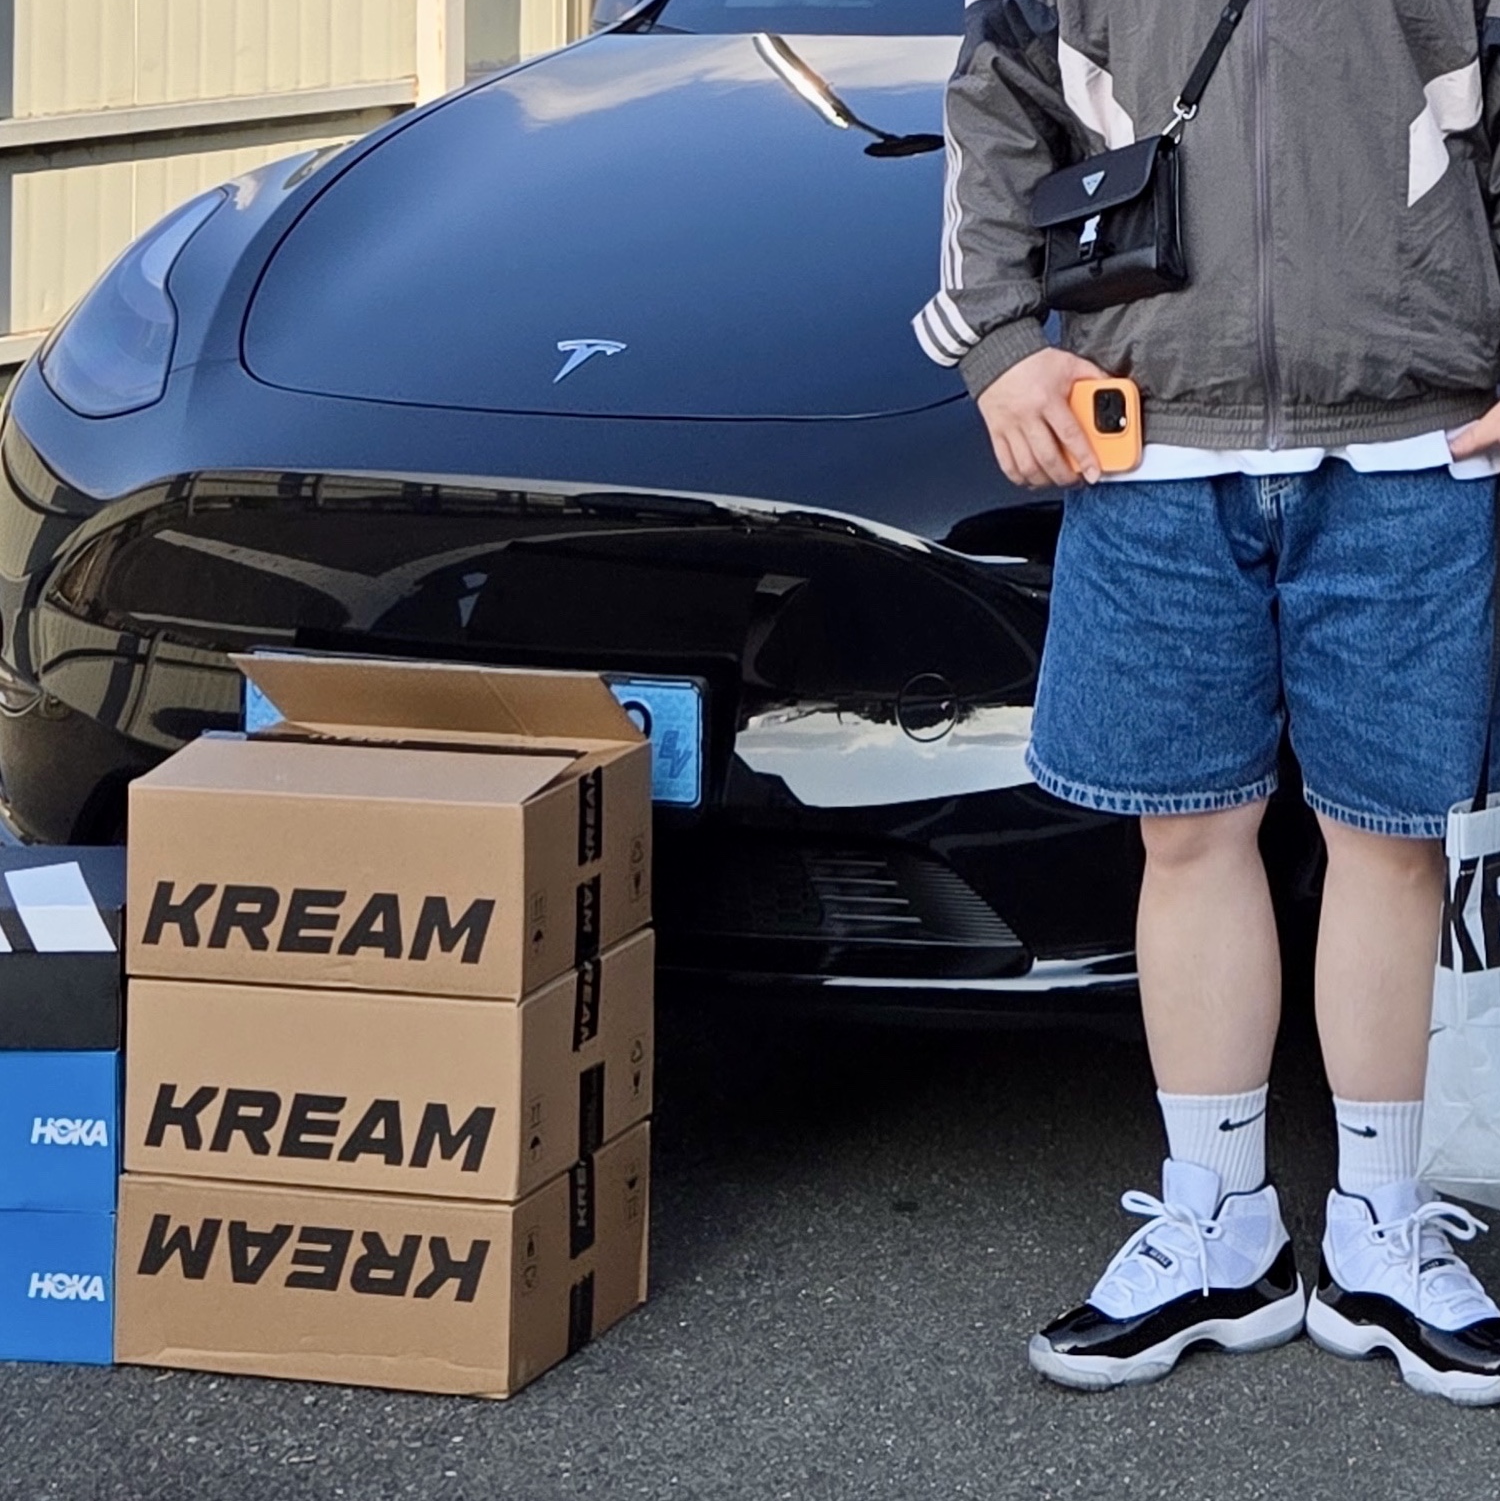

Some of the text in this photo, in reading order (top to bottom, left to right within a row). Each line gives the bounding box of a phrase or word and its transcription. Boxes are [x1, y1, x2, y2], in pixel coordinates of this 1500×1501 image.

[142, 880, 496, 964] KREAM
[30, 1117, 109, 1147] HOKA
[144, 1083, 496, 1172] KREAM
[576, 1160, 588, 1228] KRE
[28, 1272, 105, 1302] HOKA
[137, 1213, 491, 1303] KREAM
